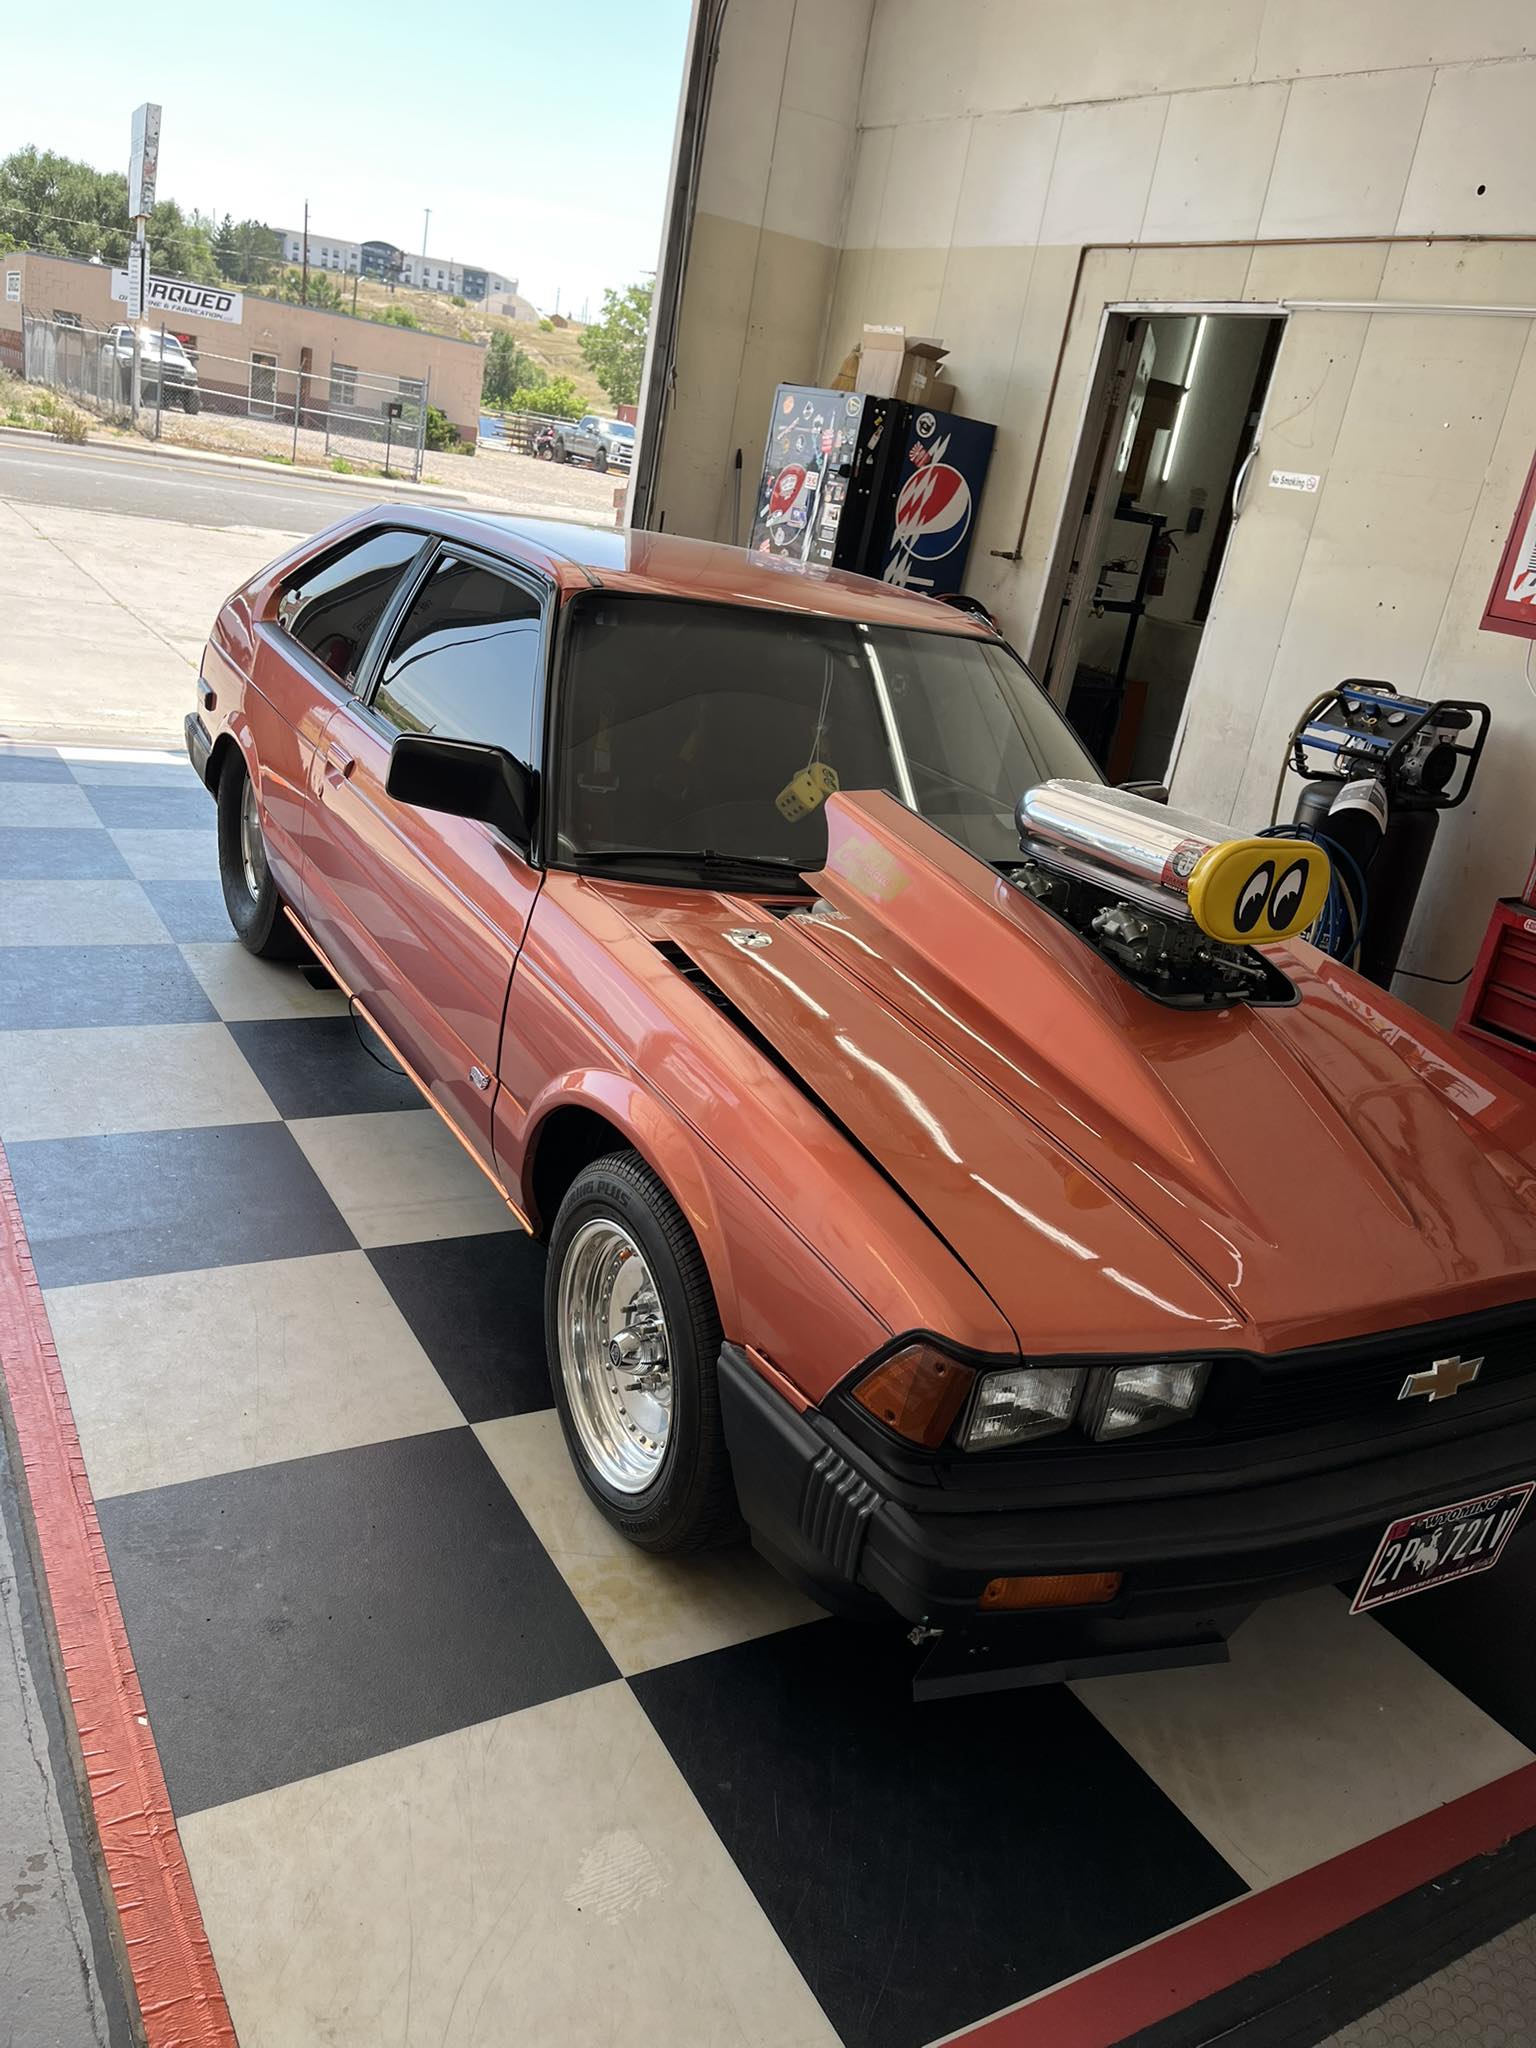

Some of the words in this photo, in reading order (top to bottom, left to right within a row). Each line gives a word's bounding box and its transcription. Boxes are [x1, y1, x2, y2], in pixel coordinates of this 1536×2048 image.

[148, 282, 232, 312] RQUED
[171, 303, 224, 320] FABRICATION
[1272, 474, 1280, 484] No
[1280, 475, 1305, 490] Smoking
[597, 1181, 631, 1209] PLUS
[1423, 1497, 1499, 1529] WYOMING
[1371, 1537, 1421, 1587] 2P
[1438, 1508, 1516, 1566] 721V
